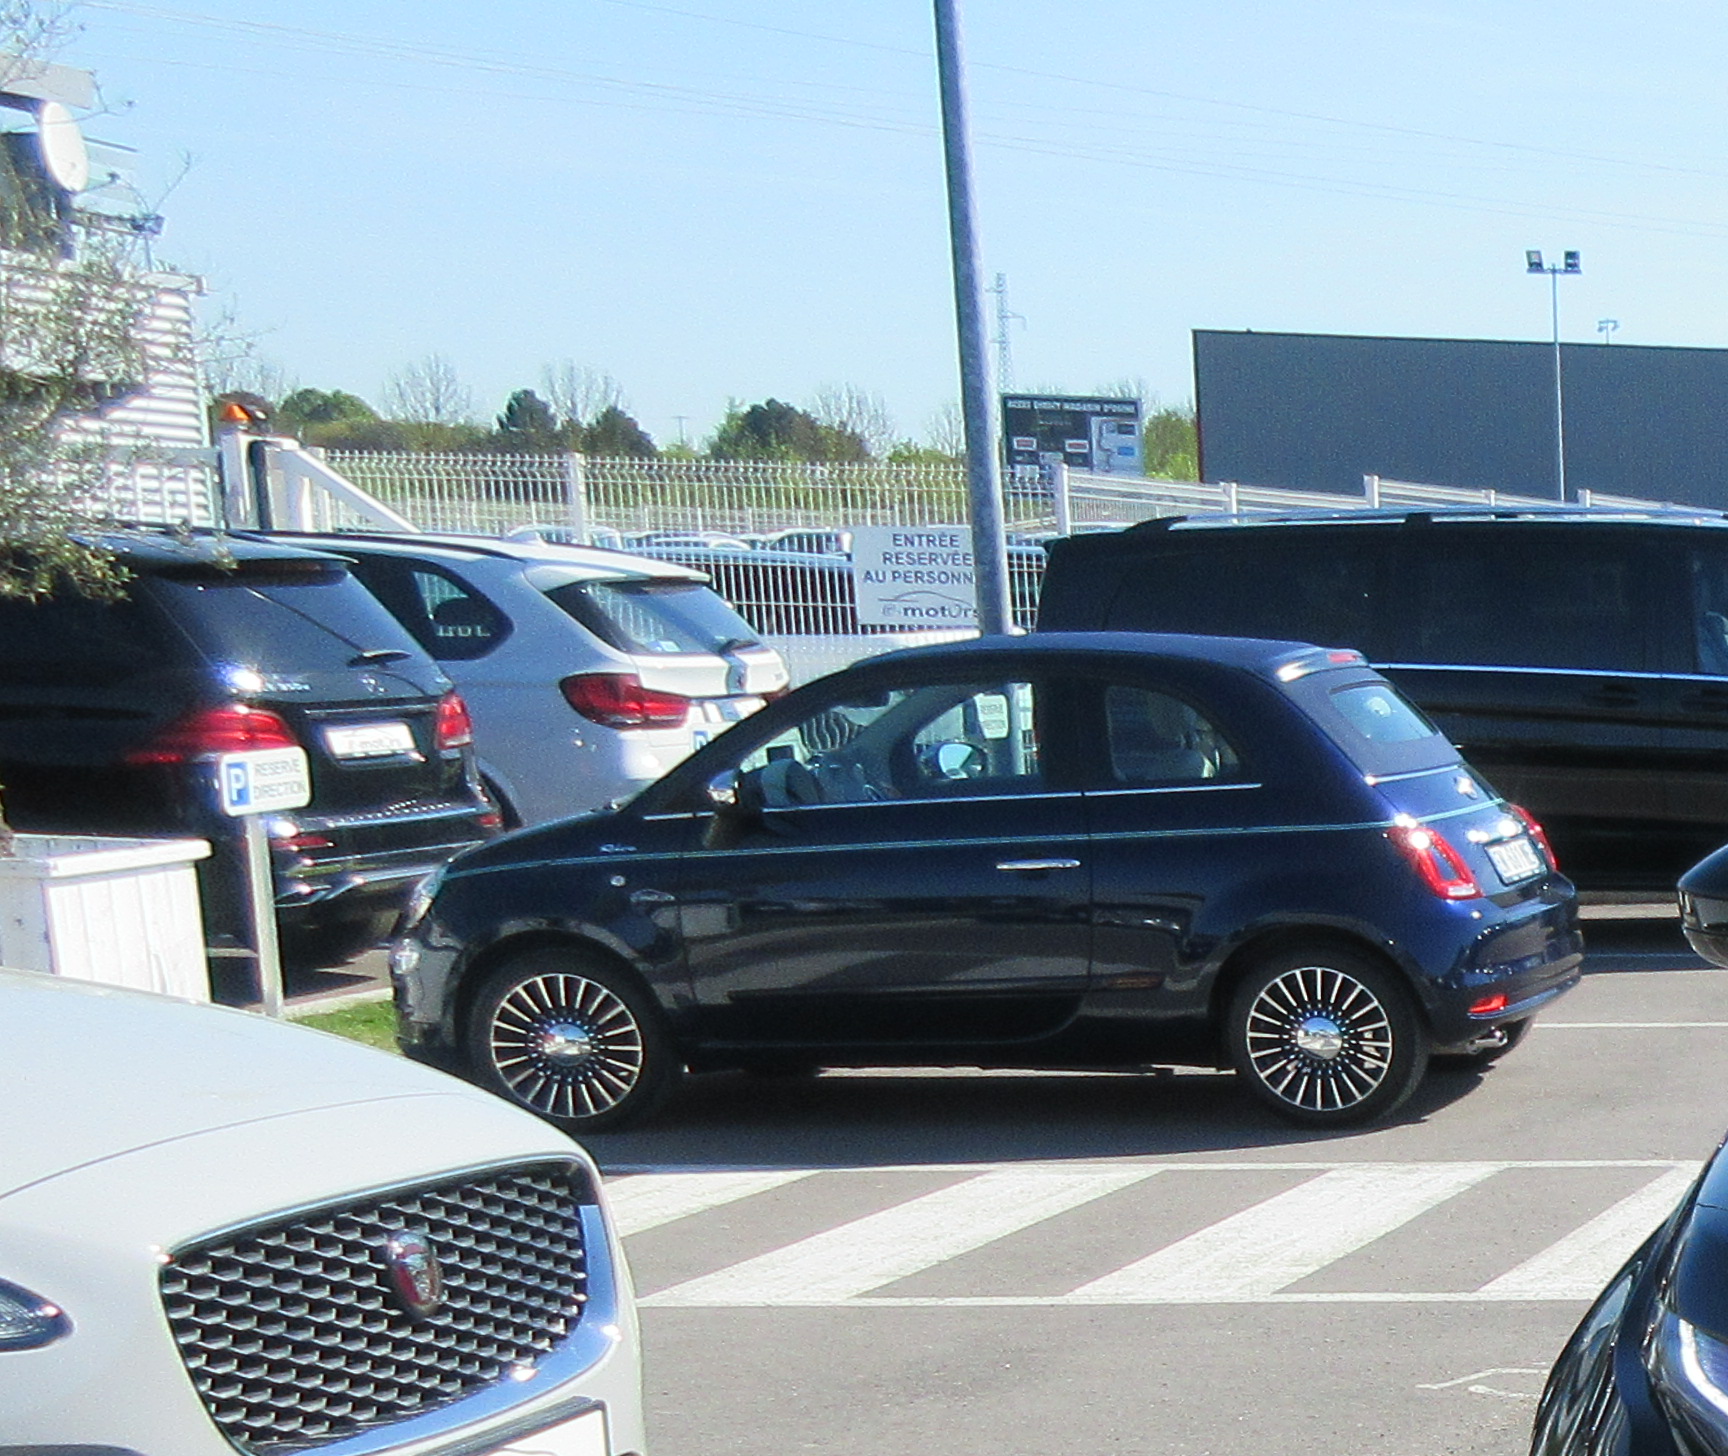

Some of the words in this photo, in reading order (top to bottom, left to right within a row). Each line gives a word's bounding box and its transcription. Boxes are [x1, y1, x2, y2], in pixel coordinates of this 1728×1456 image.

[892, 530, 960, 548] ENTRÉE
[863, 569, 887, 583] AU
[891, 570, 973, 585] PERSONN
